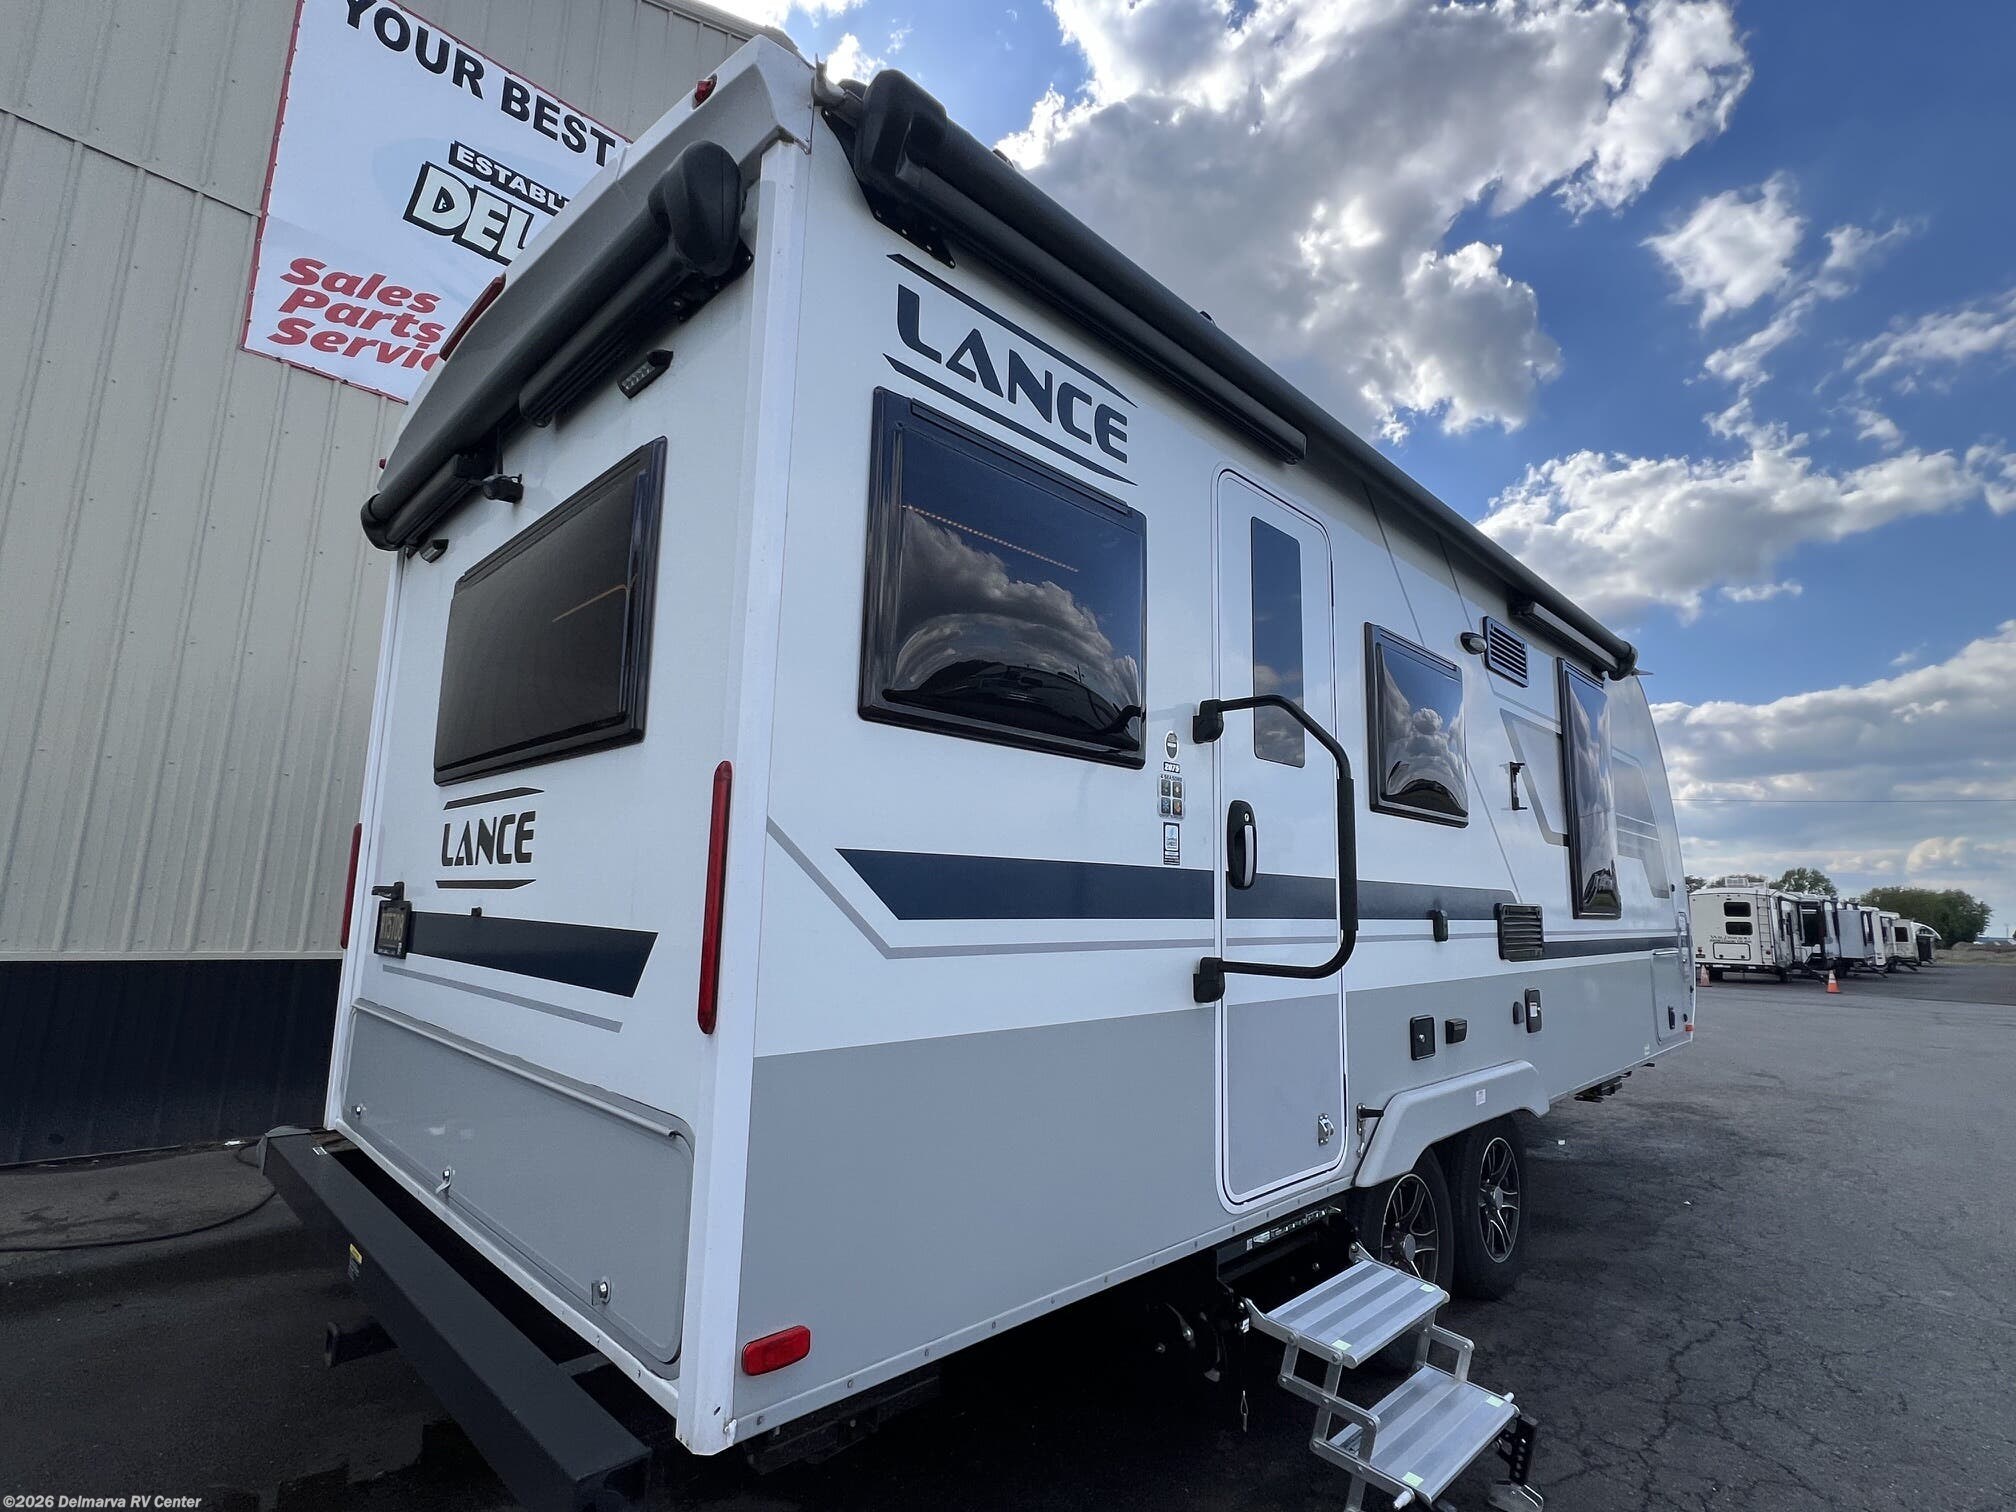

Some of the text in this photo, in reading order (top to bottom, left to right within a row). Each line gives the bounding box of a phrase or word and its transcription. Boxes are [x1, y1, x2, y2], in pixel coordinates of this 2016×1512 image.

[345, 0, 616, 168] YOUR BEST
[279, 256, 443, 314] Sales
[277, 286, 447, 344] Parts
[896, 283, 1129, 465] LANCE
[440, 810, 537, 867] LANCE
